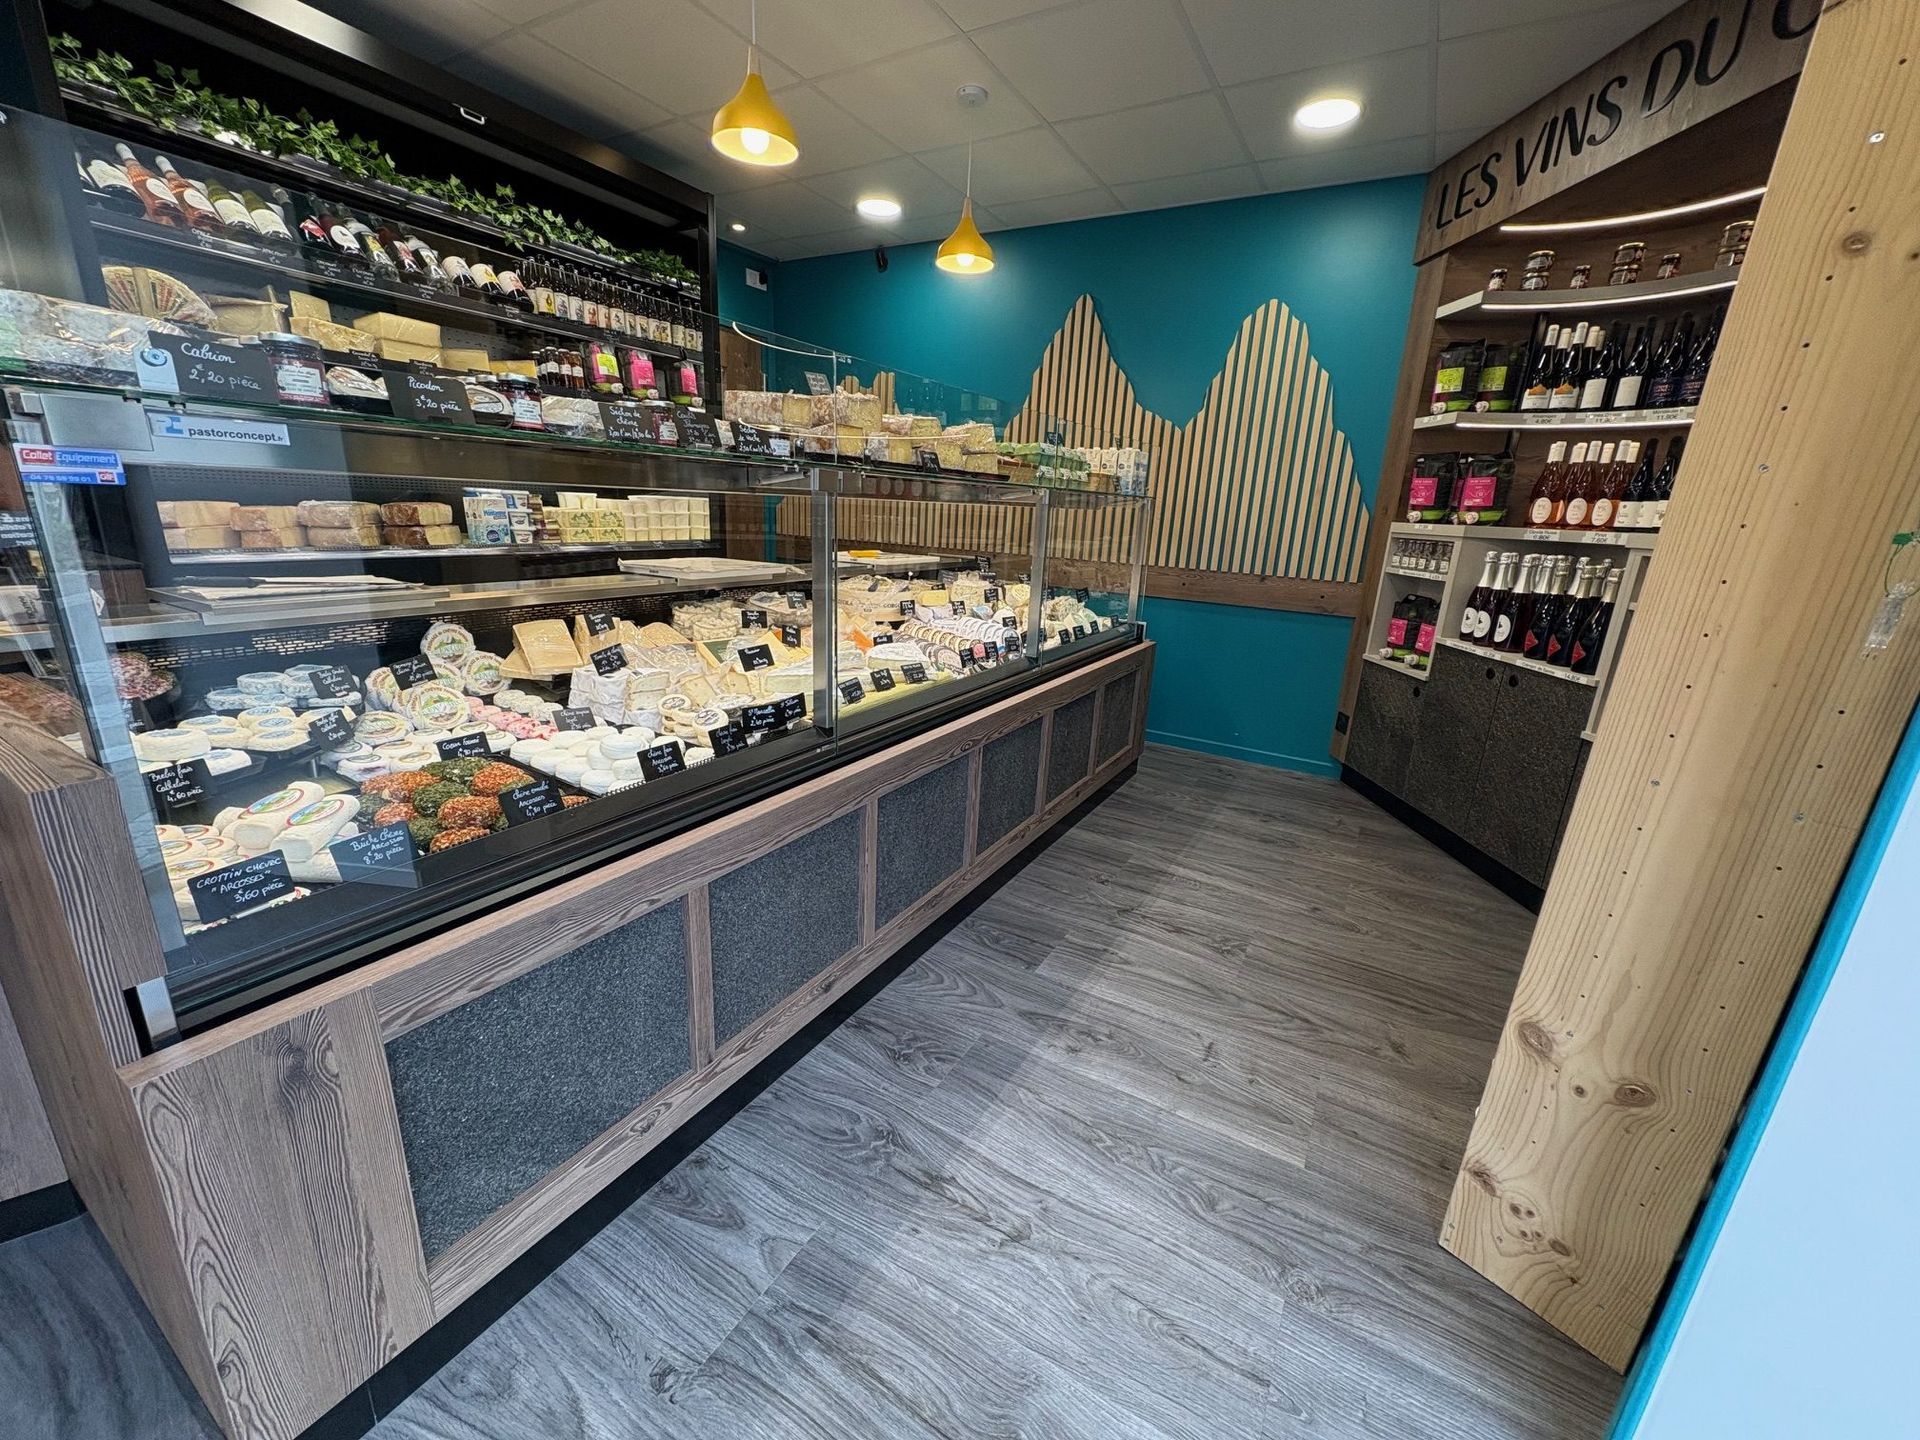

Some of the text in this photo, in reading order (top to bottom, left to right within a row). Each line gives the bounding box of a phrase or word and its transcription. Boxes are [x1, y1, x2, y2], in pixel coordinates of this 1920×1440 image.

[1436, 0, 1754, 230] LES VINS DU
[181, 342, 236, 364] Cabrion
[407, 376, 445, 392] Picodon
[22, 449, 116, 464] Collet Equipement
